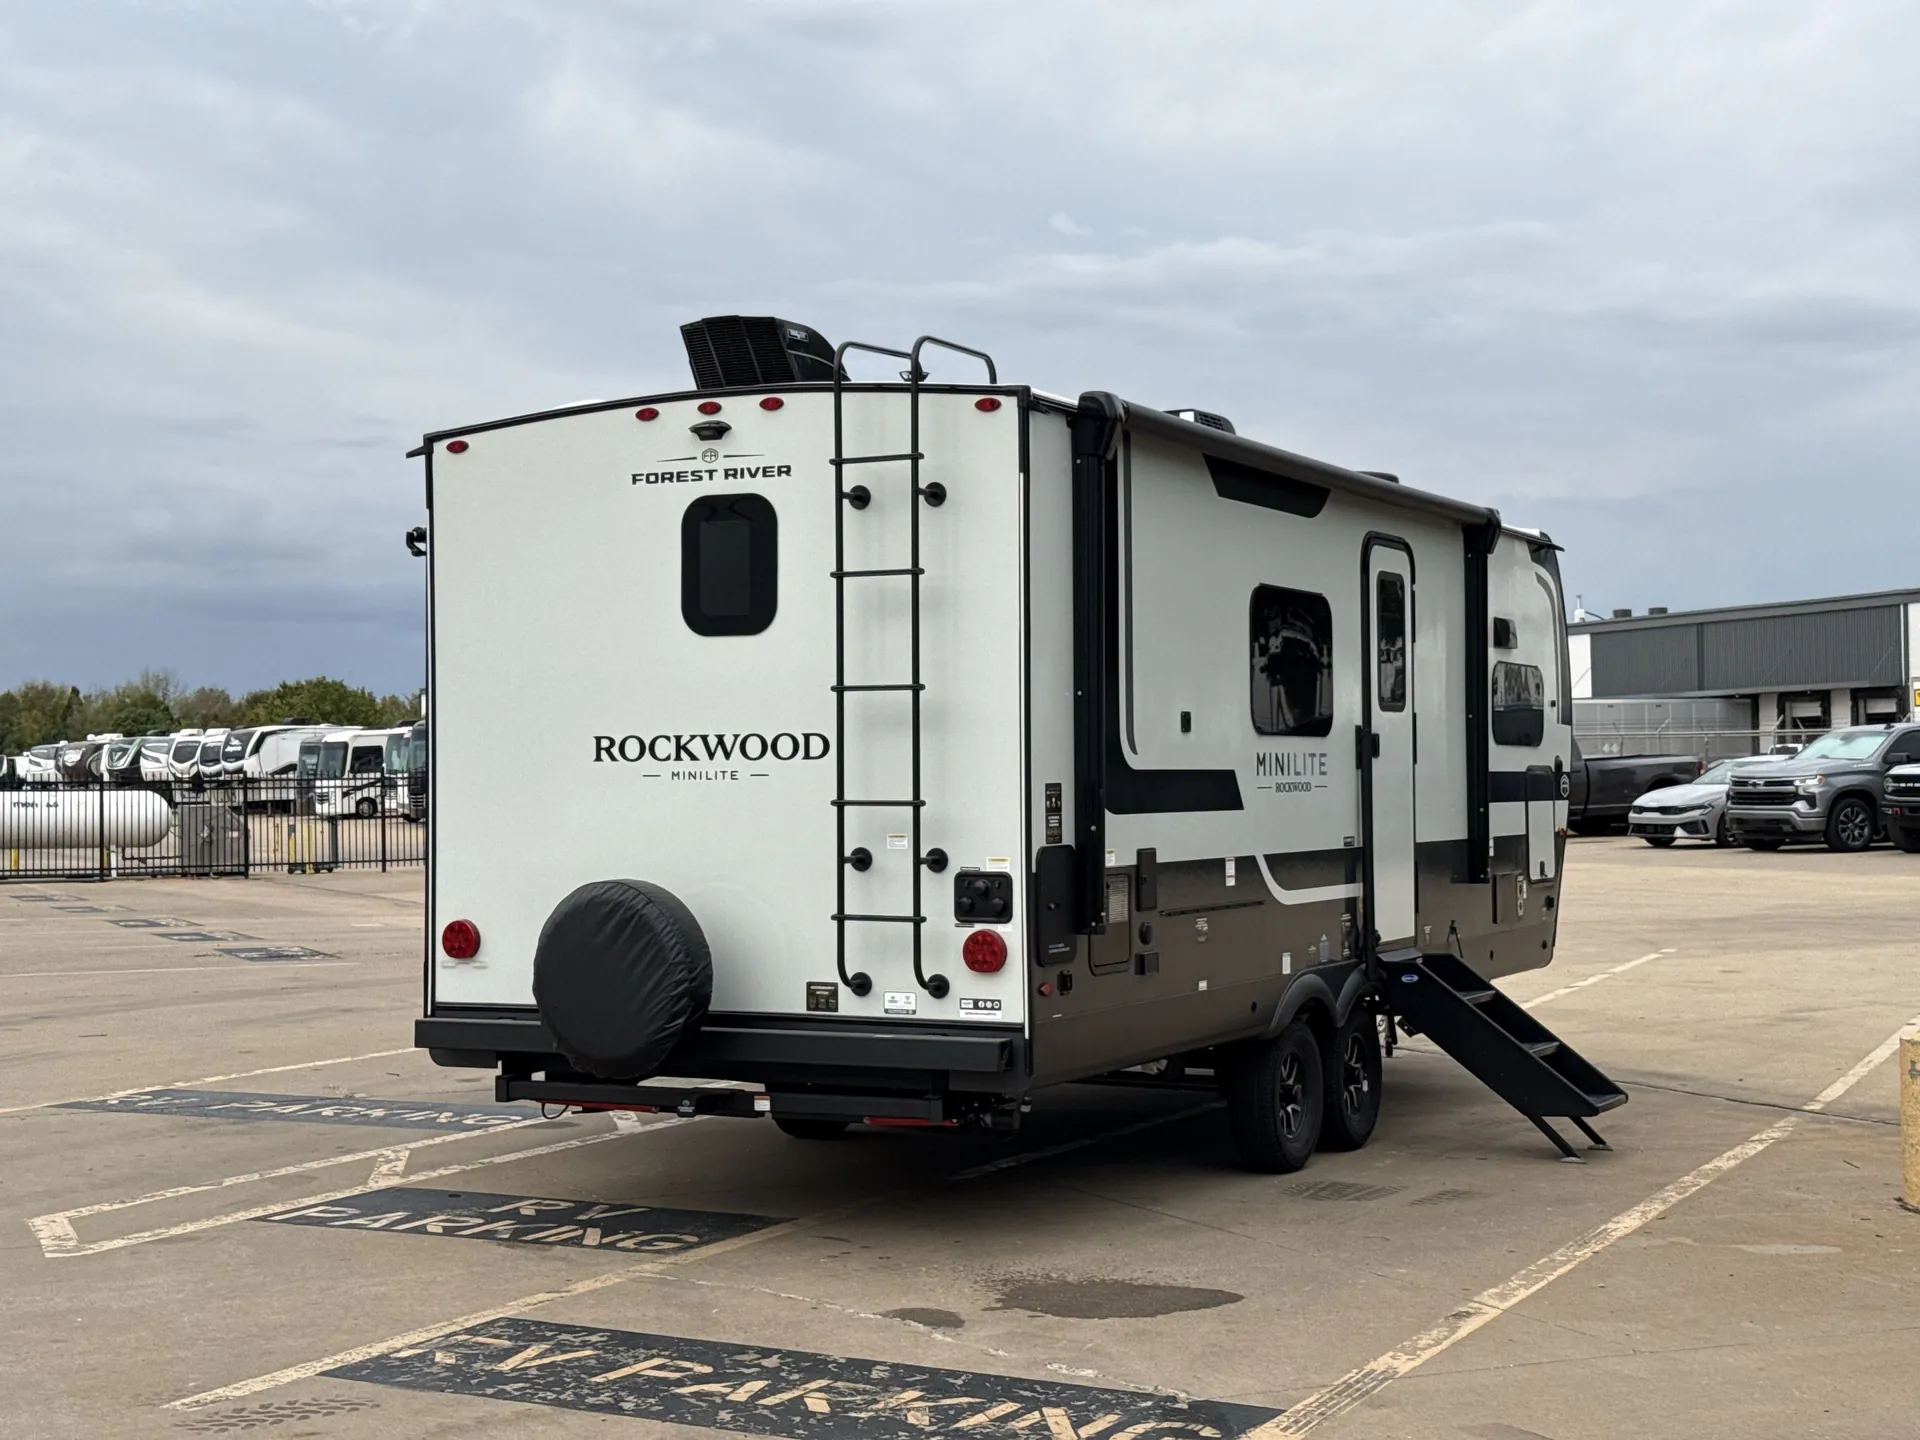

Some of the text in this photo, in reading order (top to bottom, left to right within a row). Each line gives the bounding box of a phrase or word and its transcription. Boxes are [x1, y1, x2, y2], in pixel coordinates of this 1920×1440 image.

[631, 465, 792, 485] FOREST RIVER
[593, 733, 830, 762] ROCKWOOD
[671, 770, 739, 781] MINILITE
[1256, 752, 1328, 777] MINILITE
[1275, 781, 1312, 793] ROCKWOOD
[486, 1199, 652, 1221] RV
[266, 1206, 700, 1250] PARKING
